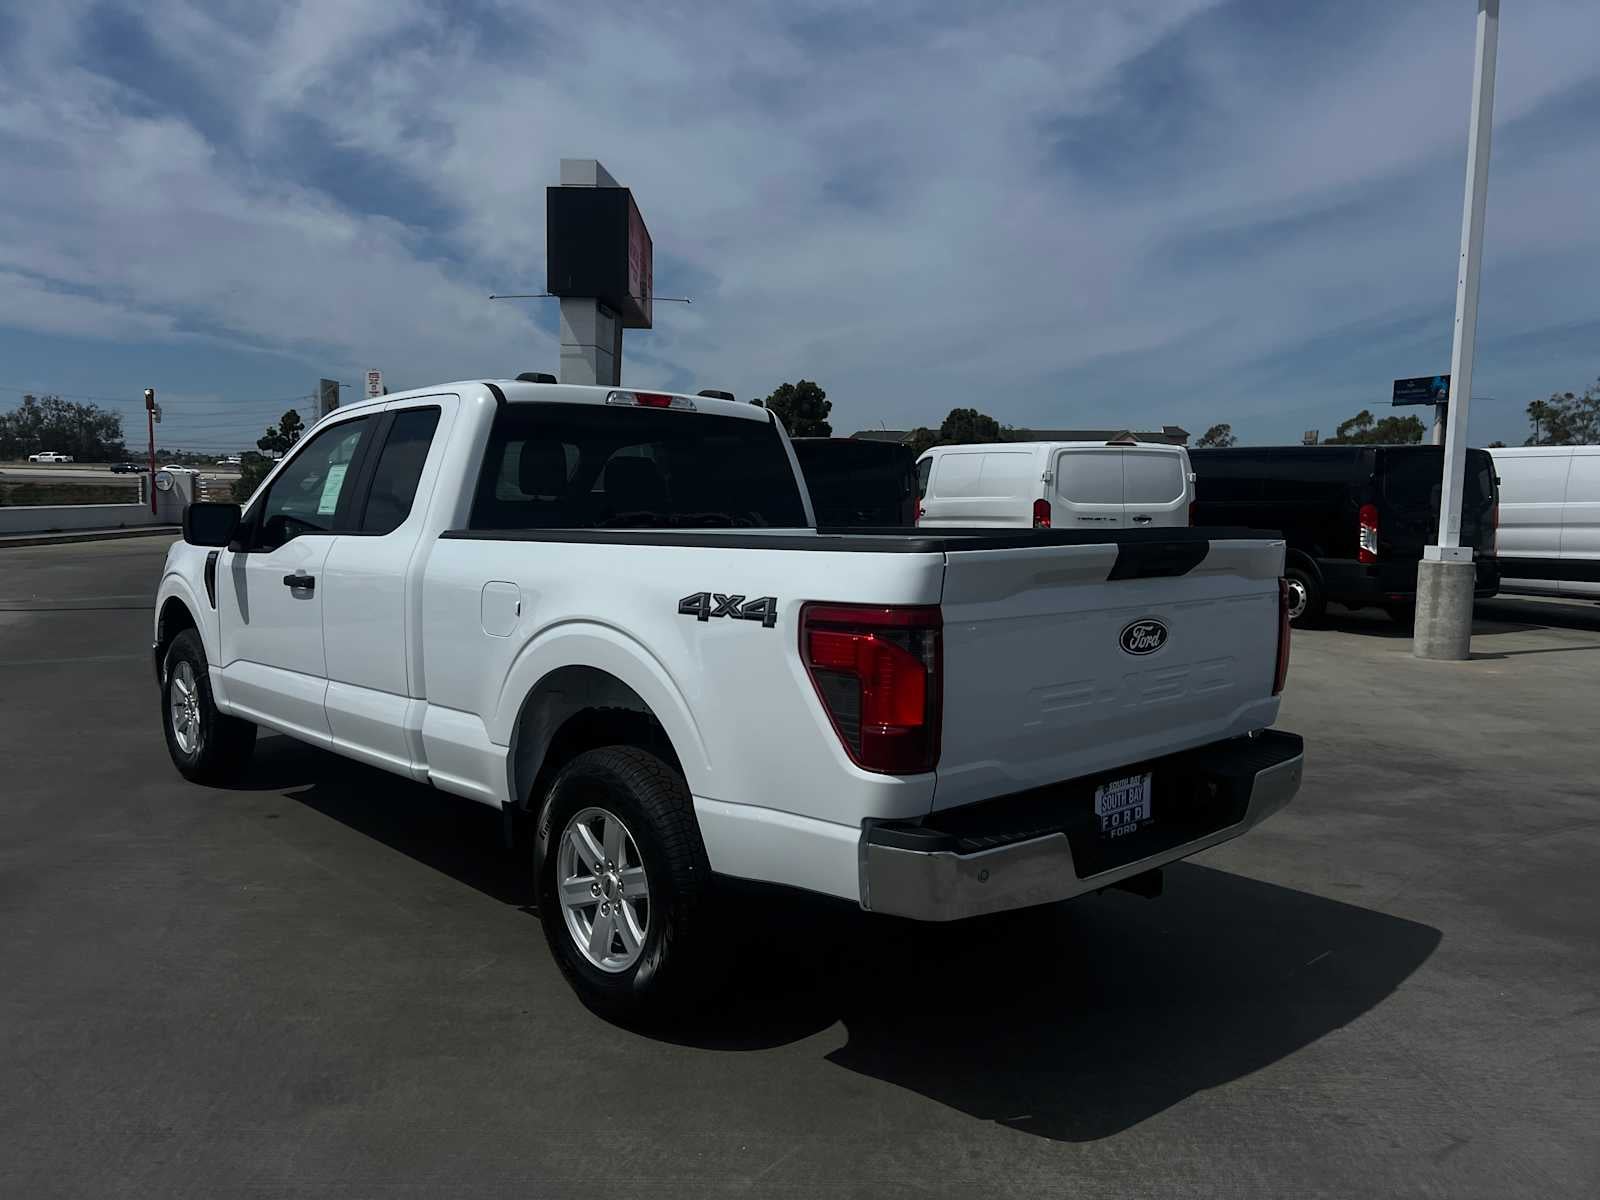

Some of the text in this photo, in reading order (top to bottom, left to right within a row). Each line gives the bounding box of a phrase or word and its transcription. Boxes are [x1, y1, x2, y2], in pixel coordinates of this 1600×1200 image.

[1129, 625, 1162, 650] Ford
[1102, 785, 1144, 811] SOUTH BAY
[1102, 806, 1142, 832] FORD
[1110, 823, 1137, 839] FORD
